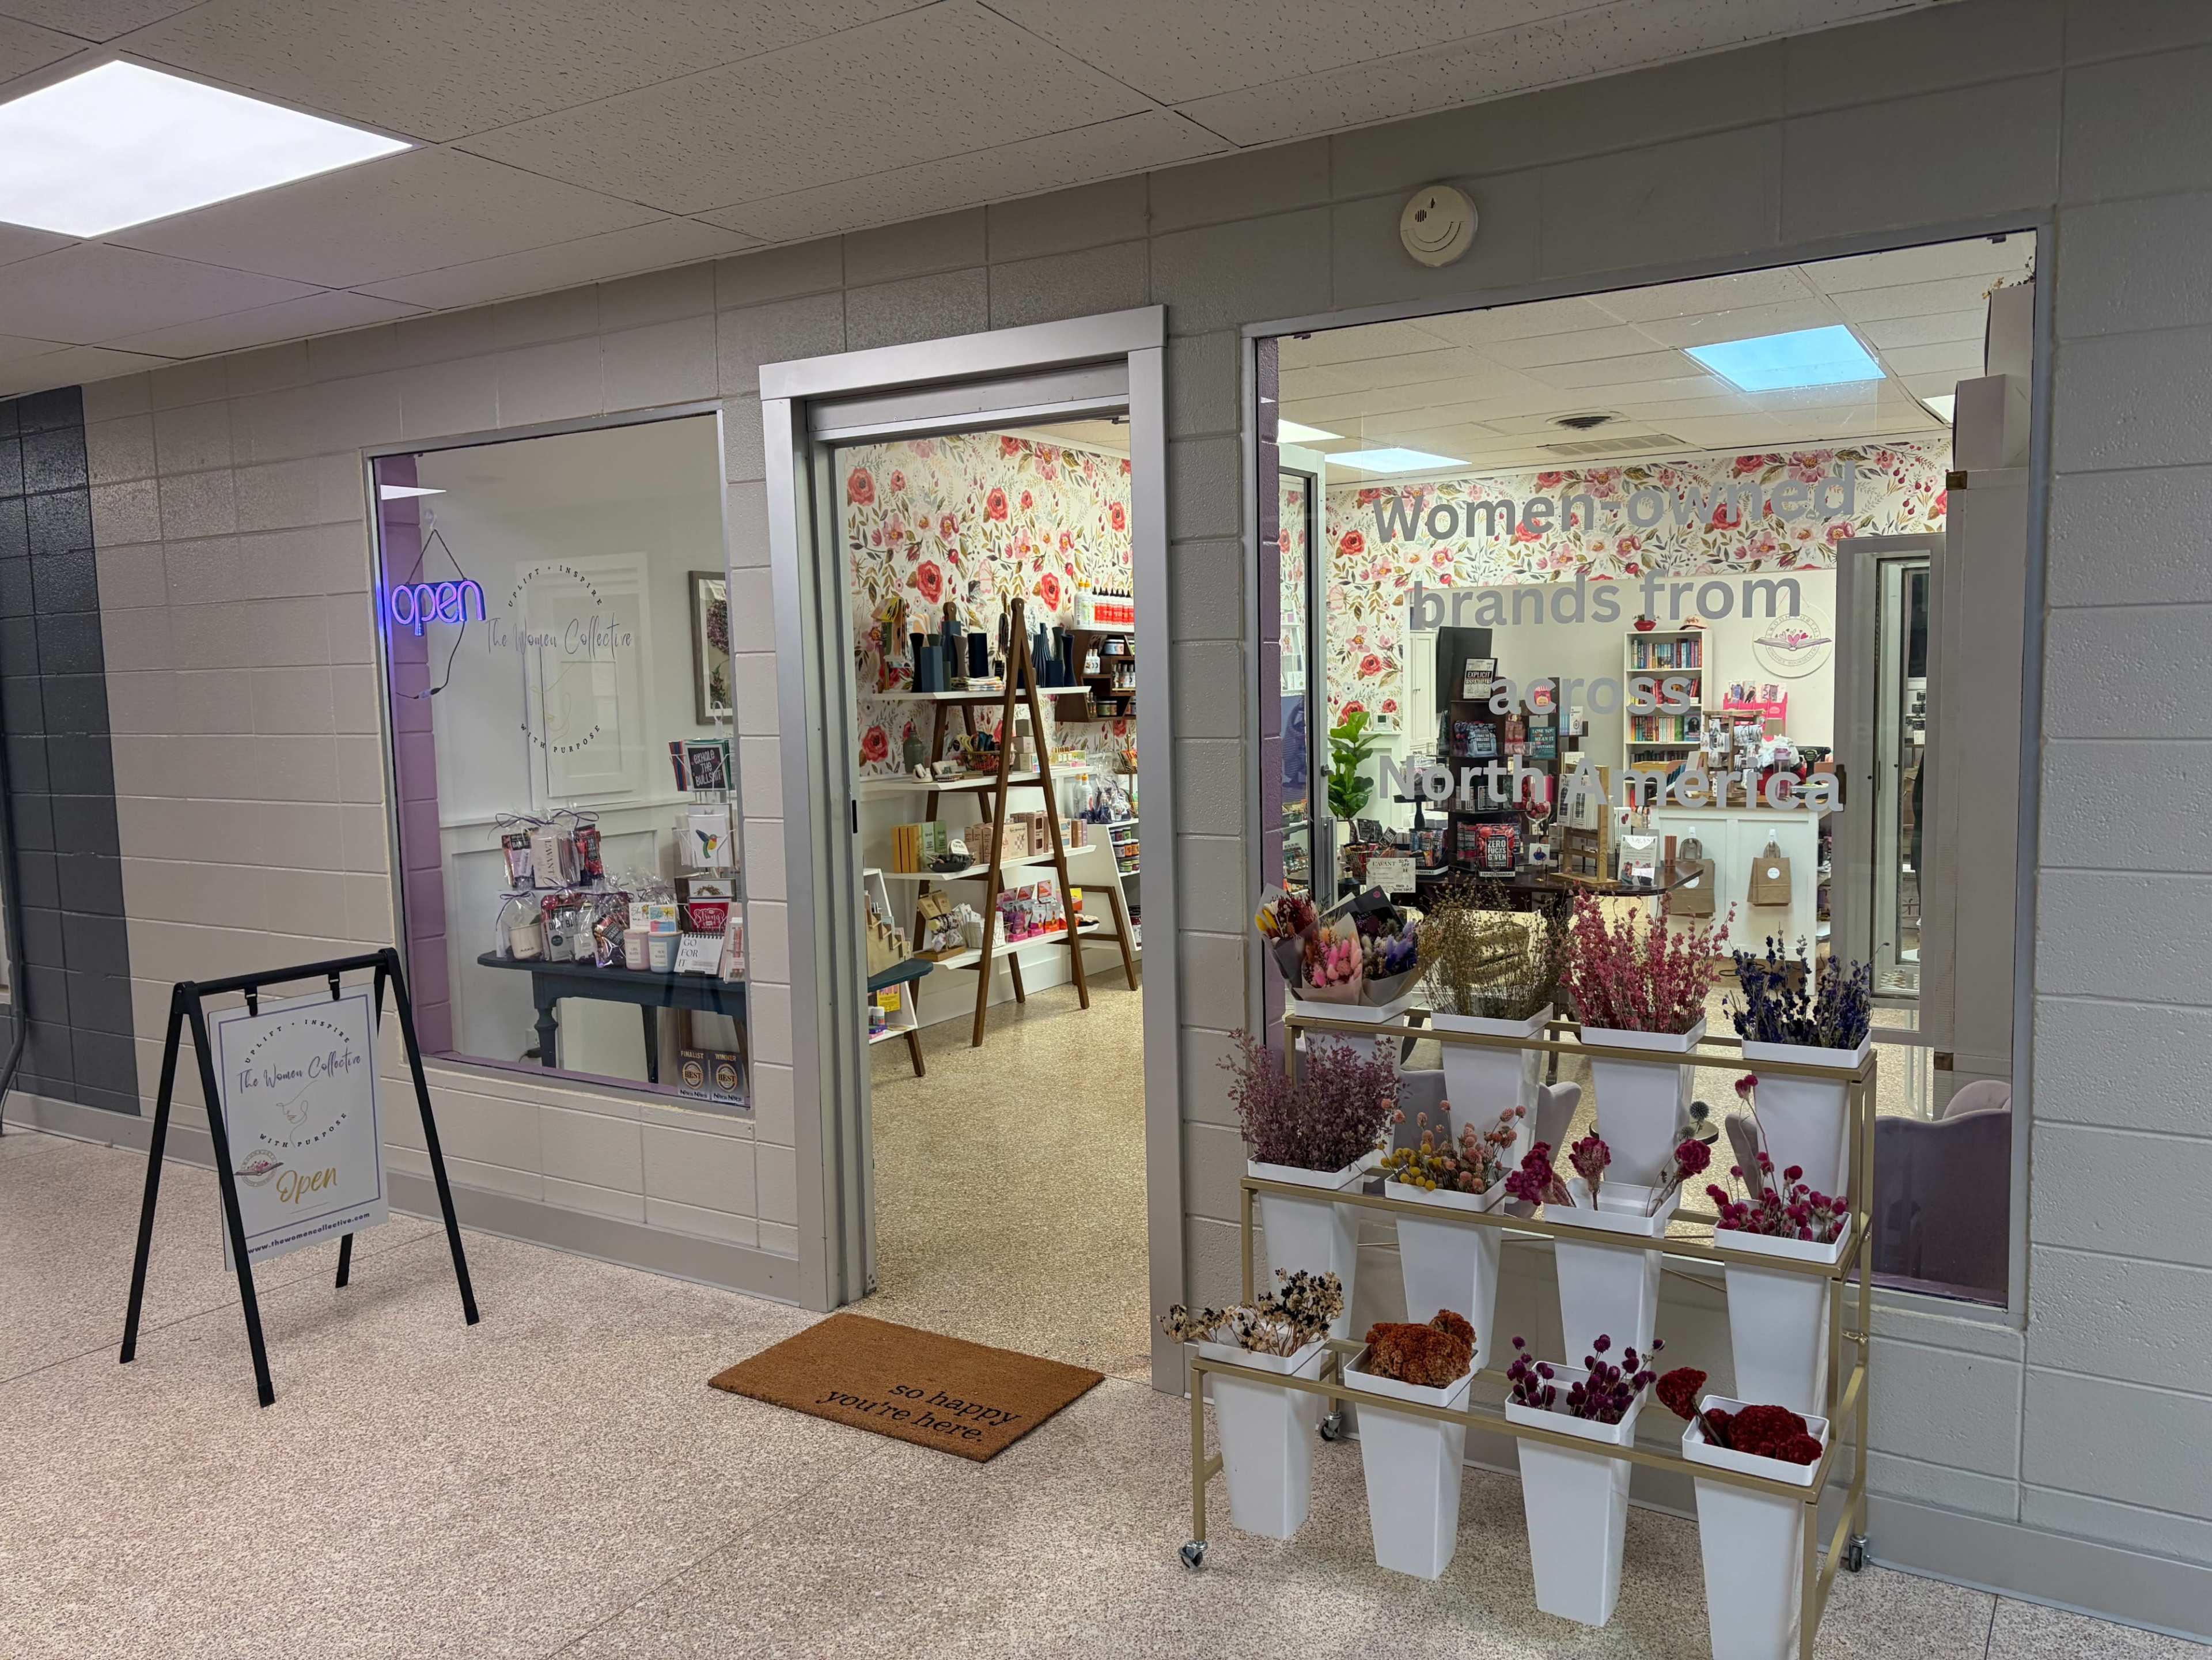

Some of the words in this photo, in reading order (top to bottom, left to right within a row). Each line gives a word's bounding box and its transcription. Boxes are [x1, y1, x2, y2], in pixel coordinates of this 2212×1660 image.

[1373, 460, 1855, 544] Women-owned
[508, 568, 540, 607] UPLIFT
[559, 565, 602, 606] INSPIRE
[1410, 573, 1621, 630] brands
[1639, 569, 1801, 621] from
[392, 580, 486, 636] open
[1767, 615, 1819, 638] SWOONORTHY
[485, 617, 507, 655] The
[514, 617, 557, 655] Women
[564, 612, 632, 660] Collective
[1488, 676, 1692, 716] across
[520, 723, 546, 749] WITH
[553, 725, 600, 753] PURPOSE
[1379, 754, 1546, 803] North
[1564, 756, 1844, 812] America
[1487, 840, 1506, 848] ZERO
[680, 948, 698, 958] FOR
[683, 939, 697, 947] GO
[678, 959, 687, 968] IT
[245, 1026, 282, 1064] UPLIFT
[305, 1019, 350, 1043] INSPIRE
[680, 1050, 704, 1060] FINALIST
[714, 1053, 737, 1061] WINNER
[236, 1068, 259, 1094] The
[263, 1064, 302, 1088] Women
[308, 1046, 361, 1078] Collective
[684, 1071, 702, 1080] BEST
[718, 1073, 736, 1082] BEST
[260, 1133, 289, 1148] WITH
[297, 1113, 347, 1147] PURPOSE
[276, 1167, 337, 1204] Open
[248, 1212, 370, 1254] www.thewomencollective.com
[815, 1391, 911, 1421] you're
[911, 1411, 982, 1442] here.
[888, 1384, 925, 1399] so
[925, 1390, 1022, 1427] happy
